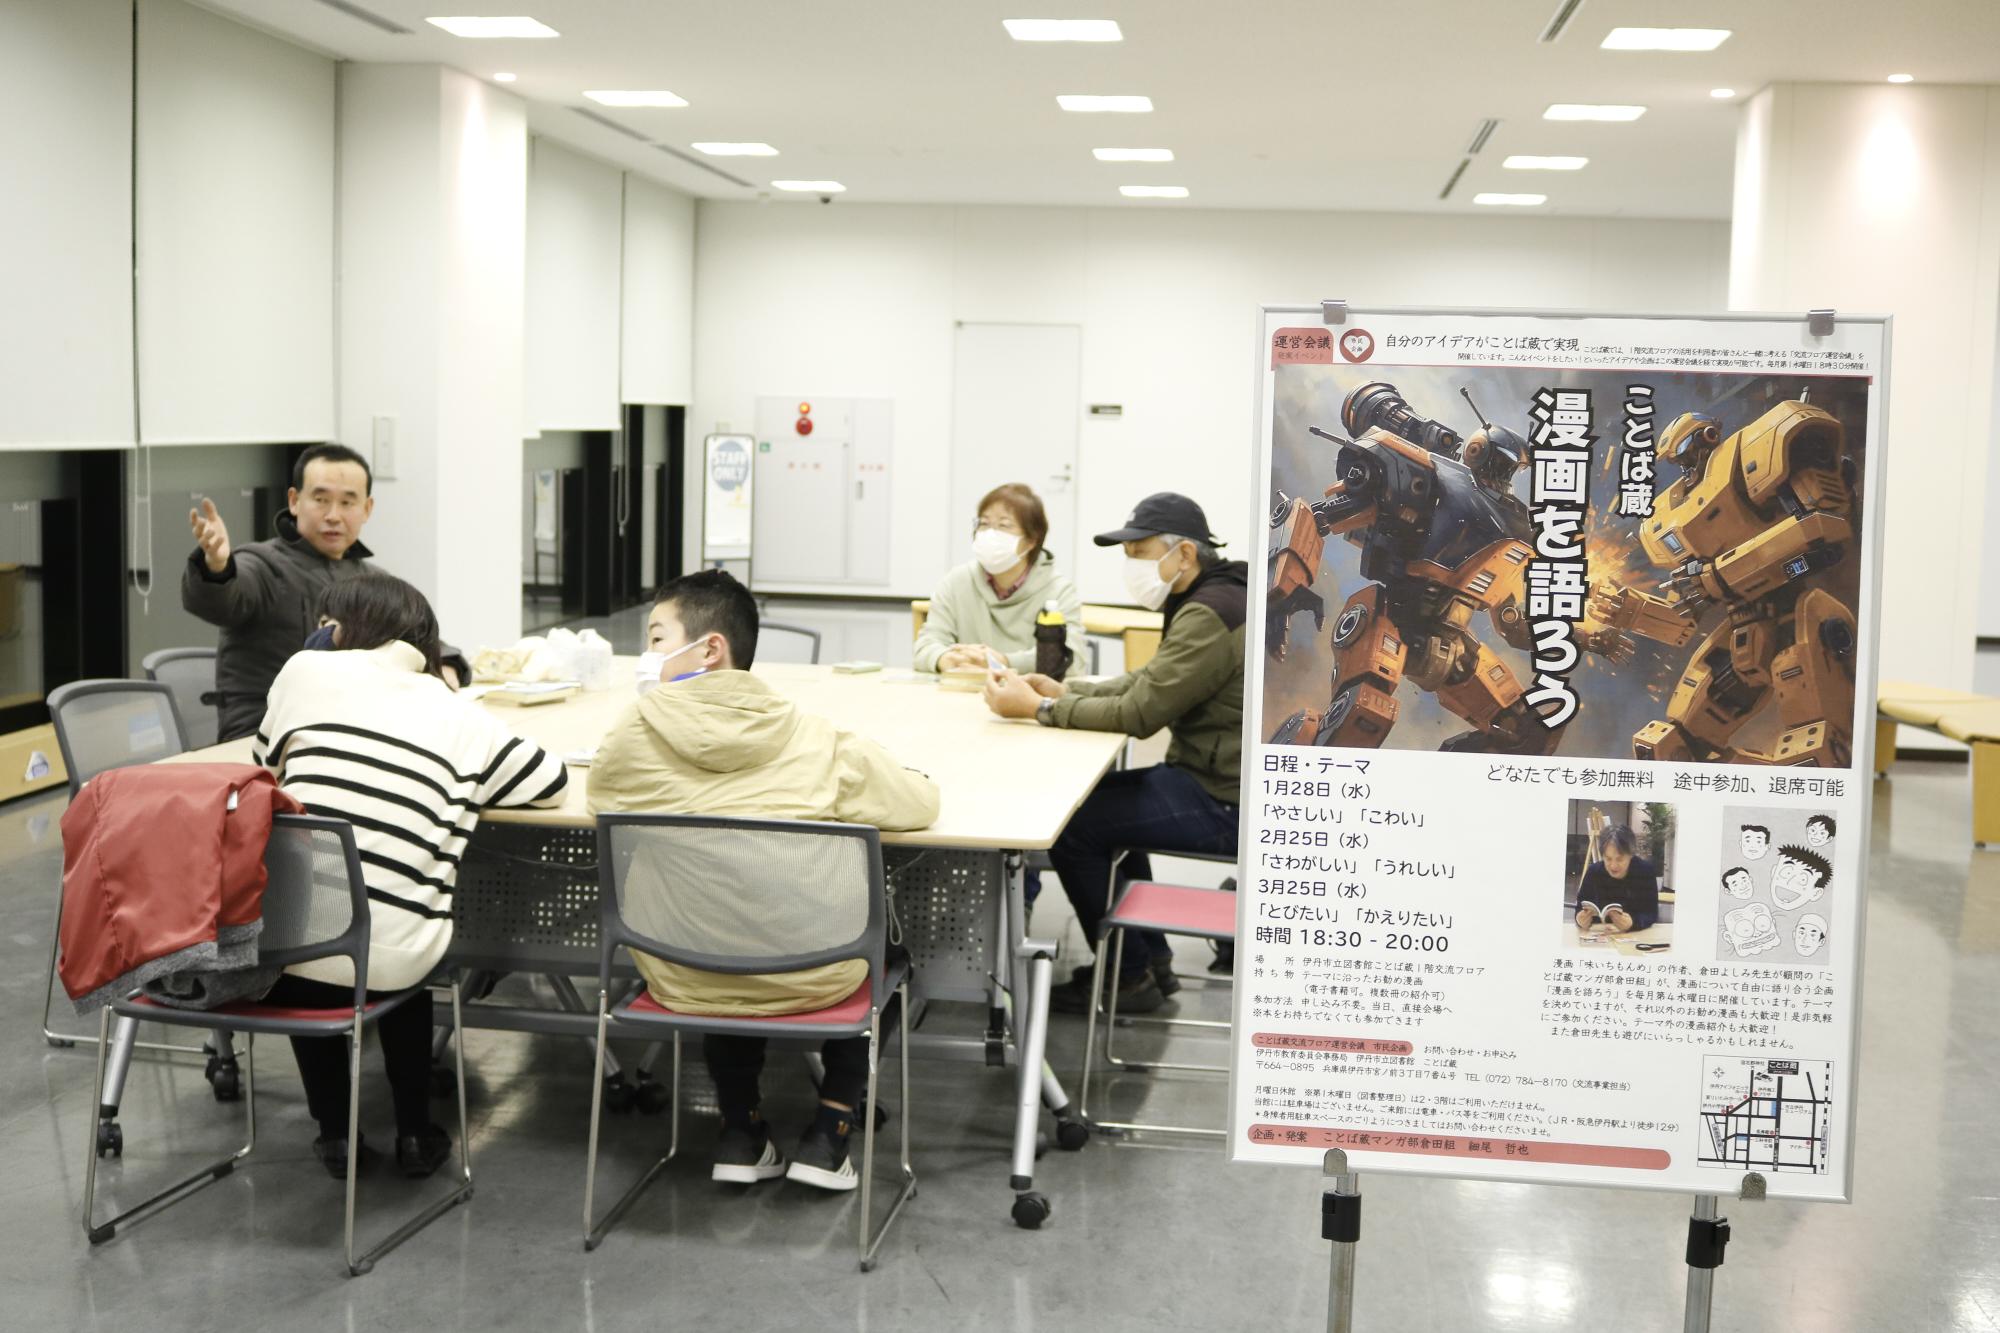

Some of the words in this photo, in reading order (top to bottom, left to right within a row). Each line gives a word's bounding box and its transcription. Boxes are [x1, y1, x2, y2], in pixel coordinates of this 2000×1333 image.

[1274, 335, 1331, 350] 運営会議
[1386, 334, 1579, 351] 自分のアイデアがことば蔵で実現
[1619, 385, 1655, 517] ことば蔵
[1526, 389, 1592, 729] 漫画を語ろう
[1264, 755, 1370, 774] 日程・テーマ
[1487, 764, 1655, 789] どなたでも参加無料
[1673, 772, 1845, 797] 途中参加、退席可能
[1256, 926, 1291, 945] 時間
[1300, 929, 1362, 947] 18:30
[1385, 933, 1449, 952] 20:00
[1302, 971, 1424, 986] テーマに沿ったお勧め漫画
[1253, 995, 1293, 1006] 参加方法
[1257, 1036, 1365, 1051] ことば蔵交流フロア運営会議
[1356, 1054, 1415, 1066] 伊丹市立図書館
[1424, 1057, 1457, 1068] ことば蔵
[1255, 1085, 1296, 1096] 月曜日休館
[1253, 1128, 1308, 1143] 企画・発案
[1323, 1131, 1455, 1150] ことば蔵マンガ部倉田組
